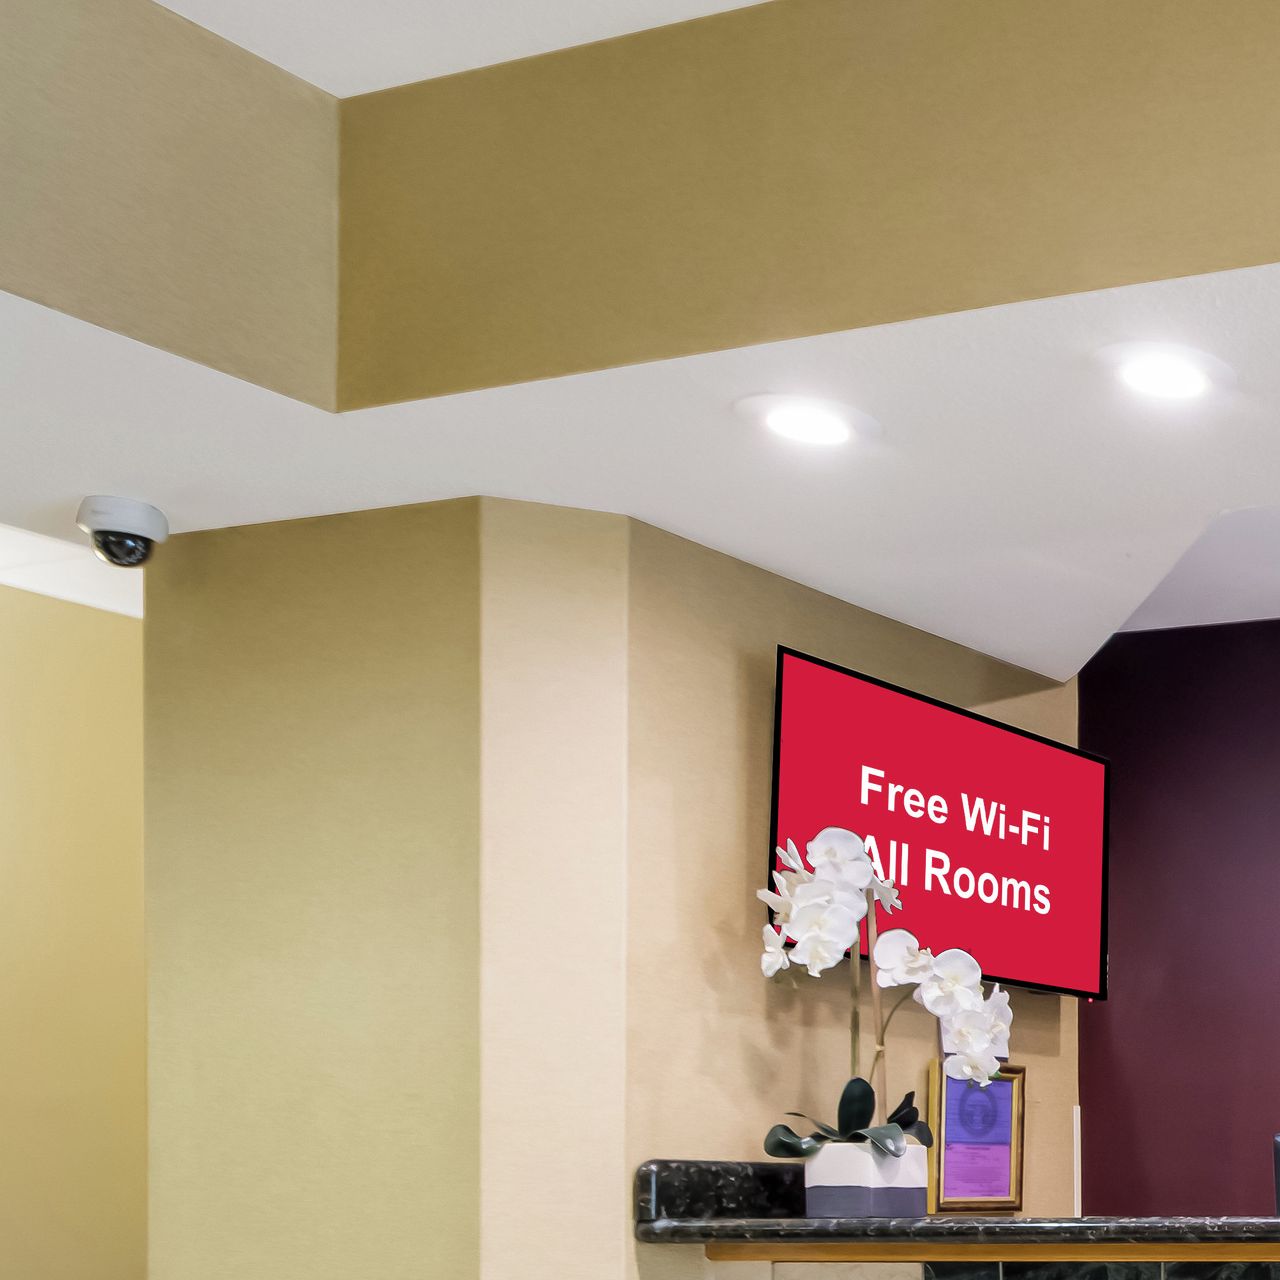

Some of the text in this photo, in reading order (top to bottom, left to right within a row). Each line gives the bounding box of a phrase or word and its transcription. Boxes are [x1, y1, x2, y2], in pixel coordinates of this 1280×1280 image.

[860, 765, 1051, 851] Free Wi-Fi
[863, 834, 1051, 915] All Rooms
